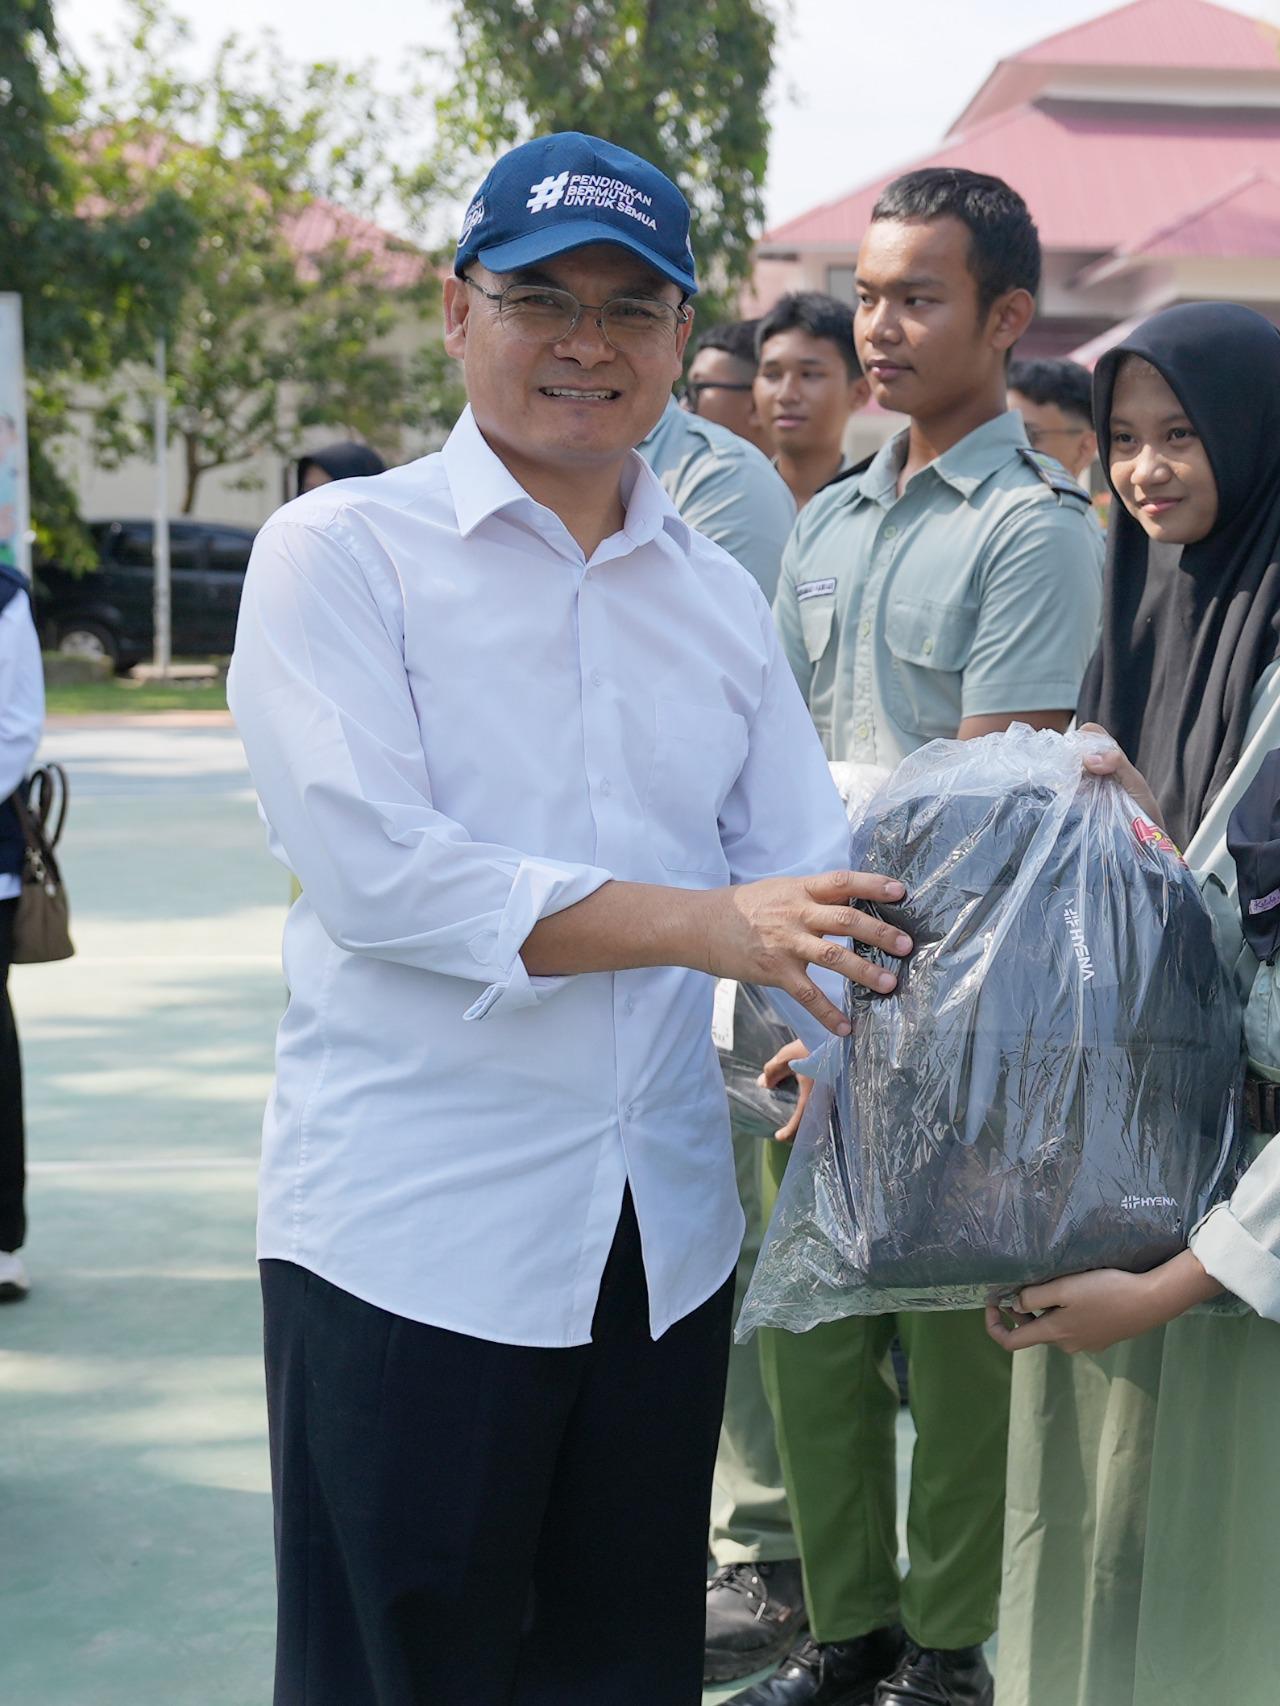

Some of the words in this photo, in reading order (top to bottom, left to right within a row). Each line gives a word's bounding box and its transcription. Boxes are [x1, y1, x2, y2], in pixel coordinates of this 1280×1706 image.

[567, 184, 635, 206] BERMUTU
[569, 174, 652, 207] PENDIDIKAN
[563, 195, 615, 209] UNTUK
[616, 201, 657, 231] SEMUA
[1069, 928, 1095, 982] HYENA
[1140, 1196, 1178, 1207] HYENA
